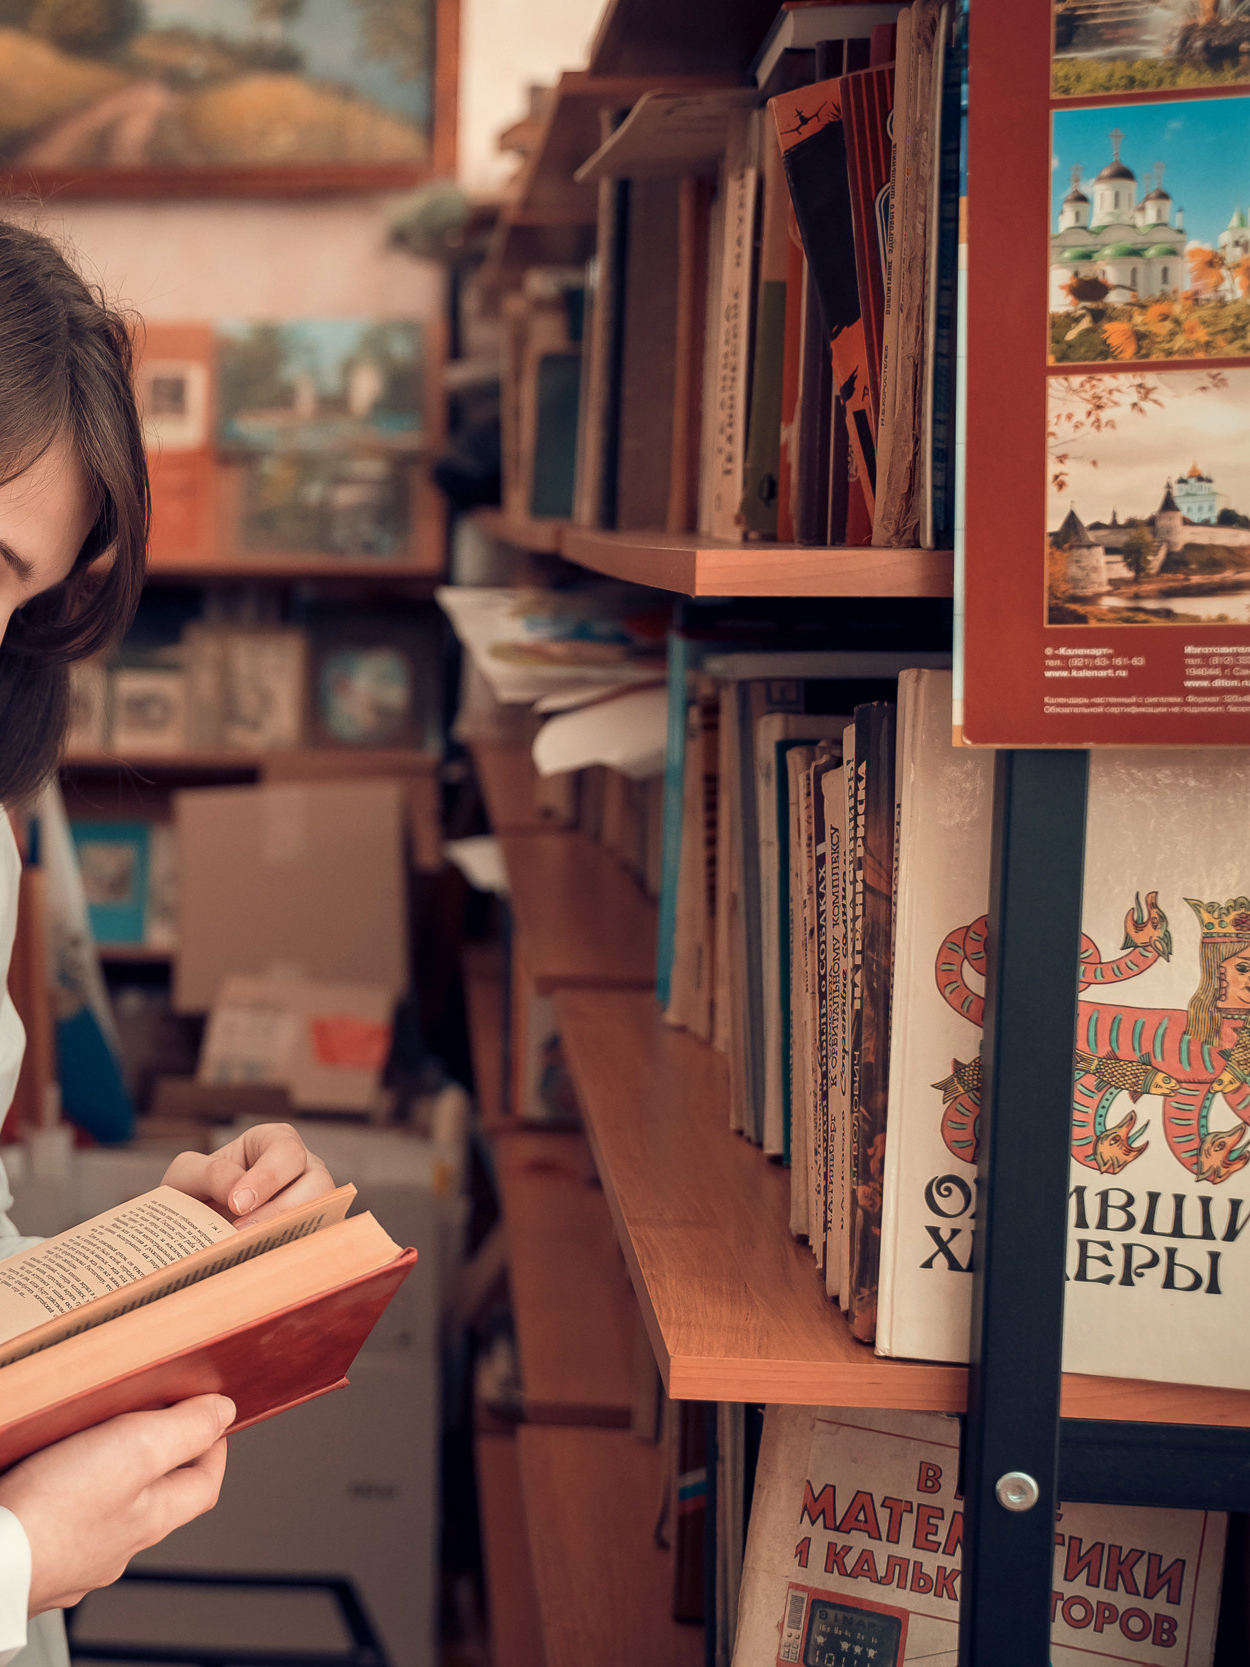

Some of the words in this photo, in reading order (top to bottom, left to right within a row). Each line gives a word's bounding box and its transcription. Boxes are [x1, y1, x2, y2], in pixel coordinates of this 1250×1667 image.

[1044, 669, 1128, 677] www.kalenart.ru
[1054, 647, 1114, 656] «Каленарт»
[1068, 658, 1093, 668] (921)
[1209, 656, 1234, 666] (812)
[855, 759, 867, 857] РИСКА
[830, 823, 840, 927] КОМПЛЕКСУ
[818, 863, 826, 975] СОБАКАХ
[853, 869, 864, 964] ГРАНИ
[830, 935, 840, 1068] ОРБИТАЛЬНОМУ
[853, 968, 861, 1009] НА
[829, 1073, 837, 1087] К
[919, 1225, 1222, 1295] ХЕРЫ
[917, 1461, 943, 1494] В
[824, 1541, 1178, 1648] КАЛЬКТОРОВ
